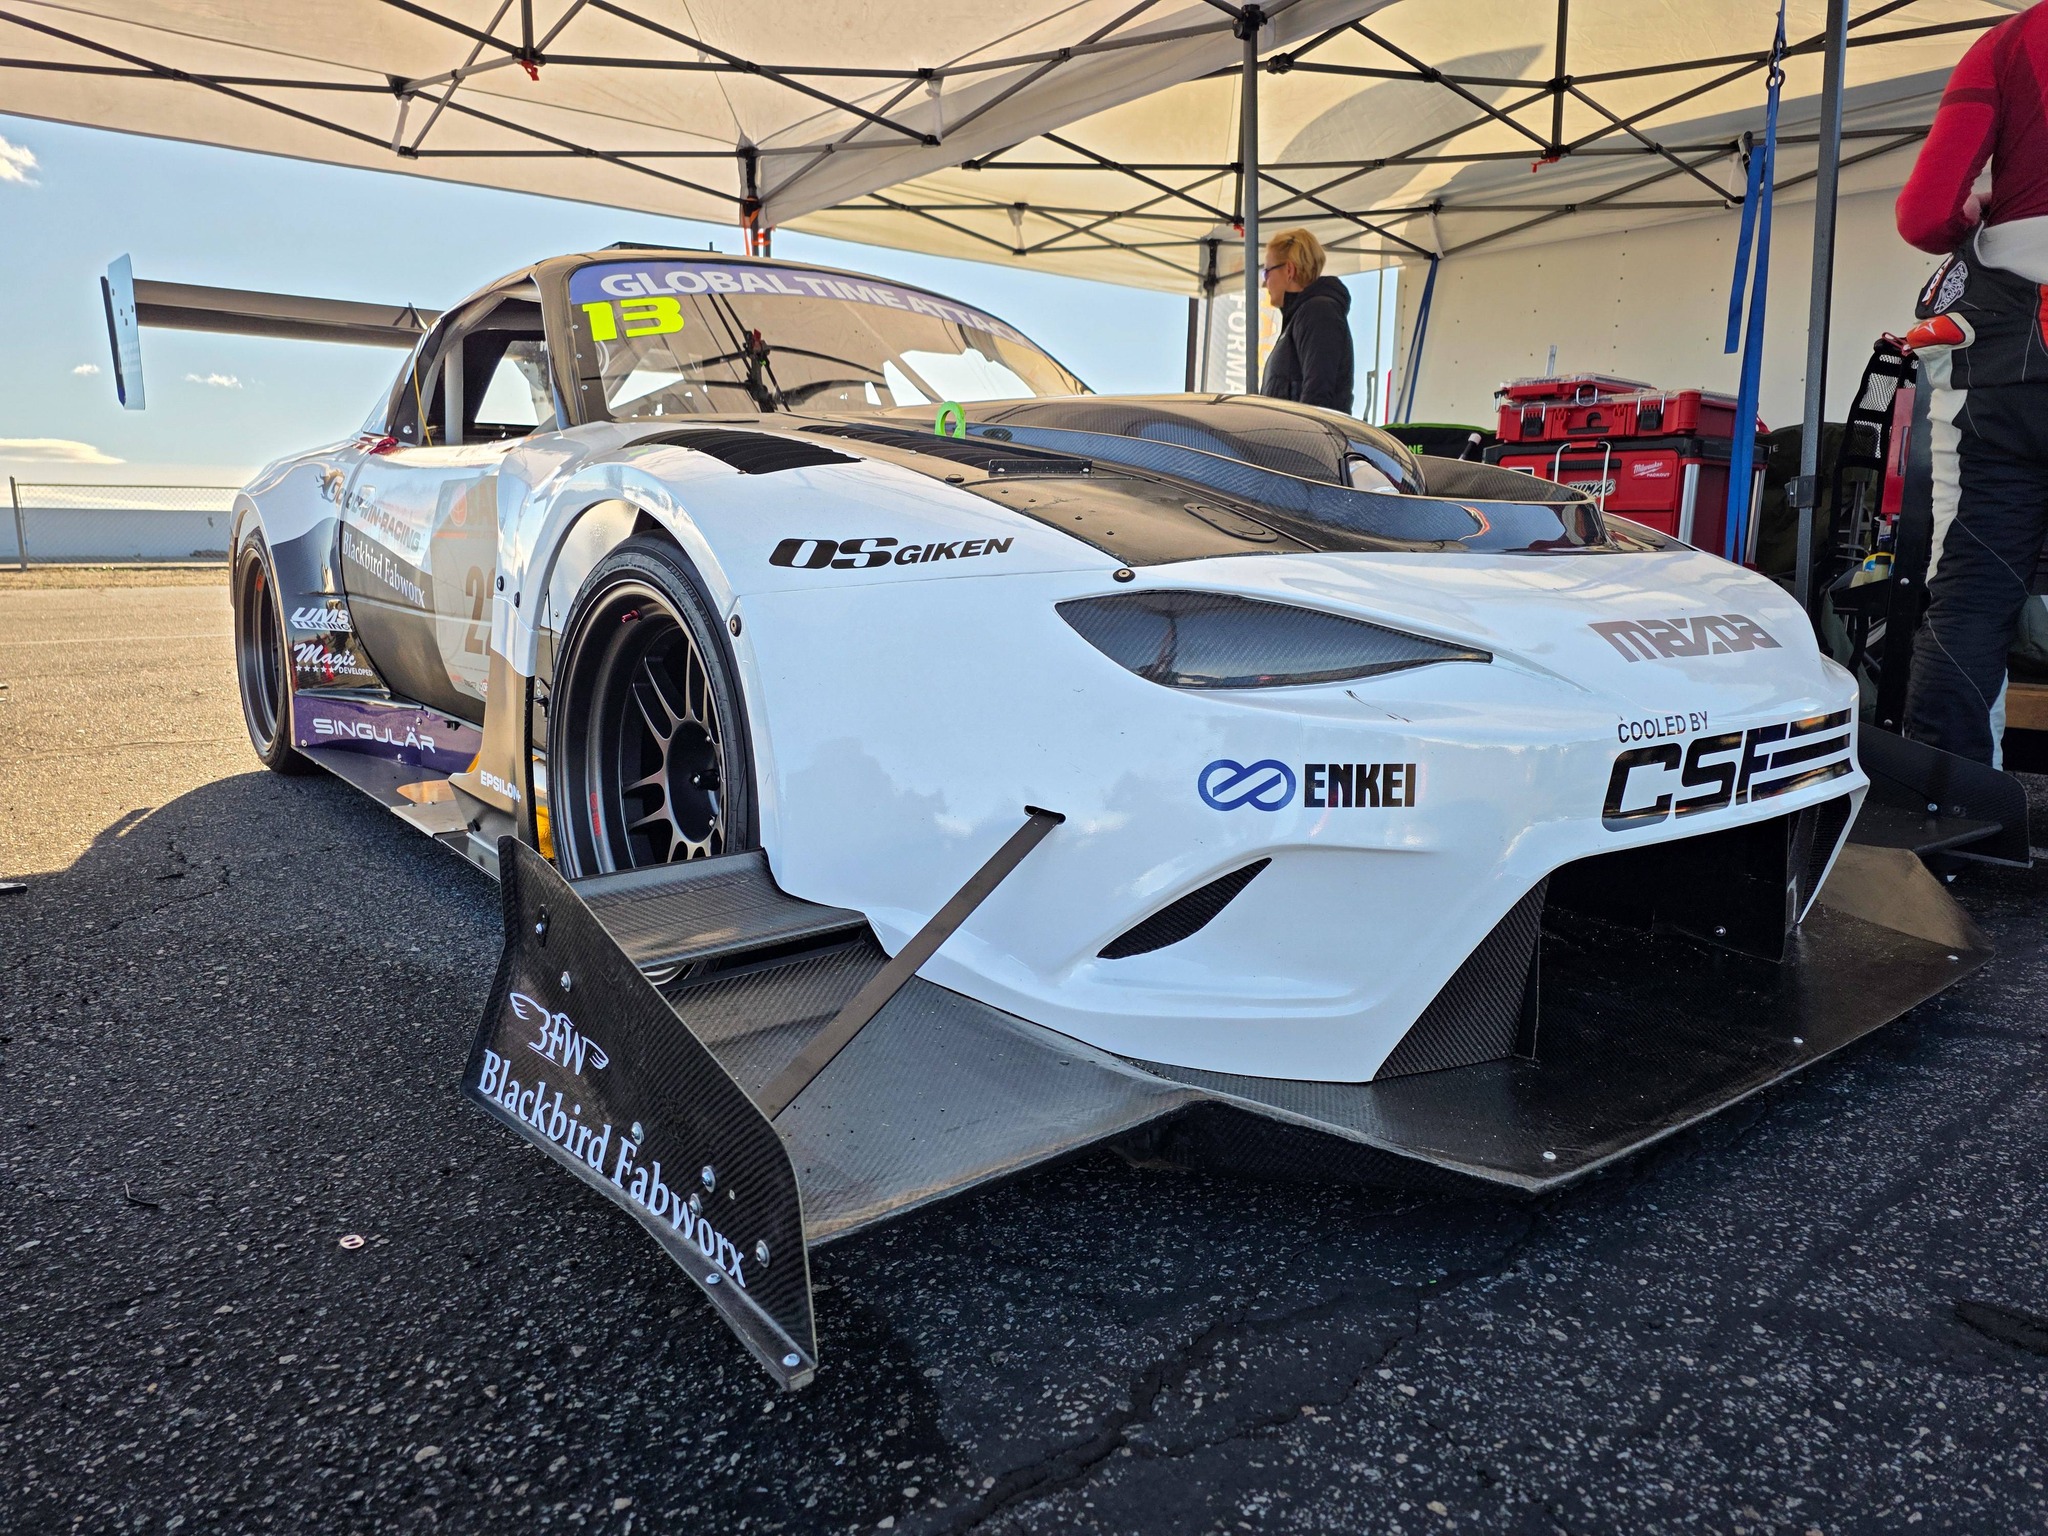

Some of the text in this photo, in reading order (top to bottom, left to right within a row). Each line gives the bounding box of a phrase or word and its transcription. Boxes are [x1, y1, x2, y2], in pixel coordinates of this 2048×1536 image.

[601, 270, 804, 297] GLOBAL
[793, 276, 909, 310] TIME
[582, 297, 684, 342] 13
[1225, 290, 1247, 395] FORMA
[343, 530, 426, 609] Blackbird Fabworx
[768, 537, 1015, 570] OS GIKEN
[291, 607, 349, 624] UMS
[292, 620, 352, 632] TUNING
[293, 643, 357, 671] Magic
[338, 666, 374, 677] DEVELOPED
[312, 718, 436, 754] SINGULÄR
[1617, 711, 1709, 744] COOLED BY
[1303, 763, 1417, 809] ENKEI
[1601, 707, 1854, 833] CSF
[477, 1048, 746, 1290] Blackbird Fabworx
